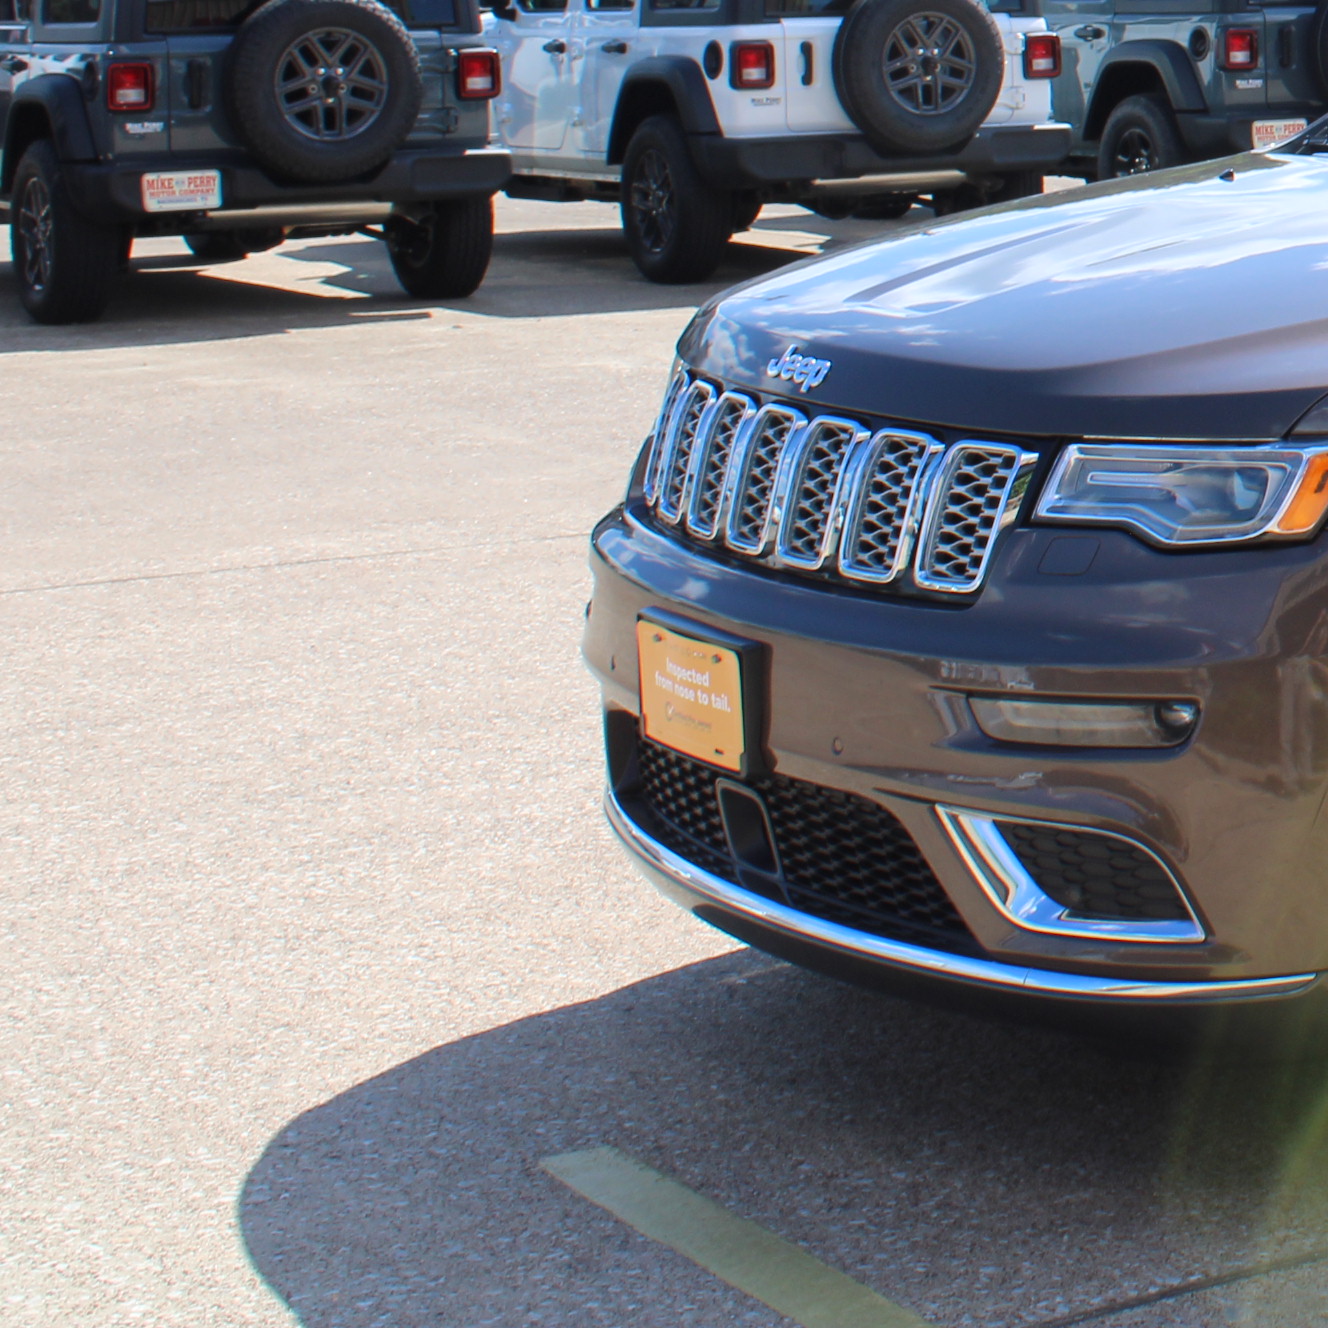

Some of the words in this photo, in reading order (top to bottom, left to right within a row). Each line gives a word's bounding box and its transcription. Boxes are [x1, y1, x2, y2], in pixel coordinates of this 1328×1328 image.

[146, 178, 174, 191] MIKE
[187, 175, 217, 188] PERRY
[766, 343, 832, 392] Jeep
[655, 670, 673, 692] from
[675, 683, 695, 702] nose
[697, 689, 709, 706] to
[666, 656, 710, 688] Inspected
